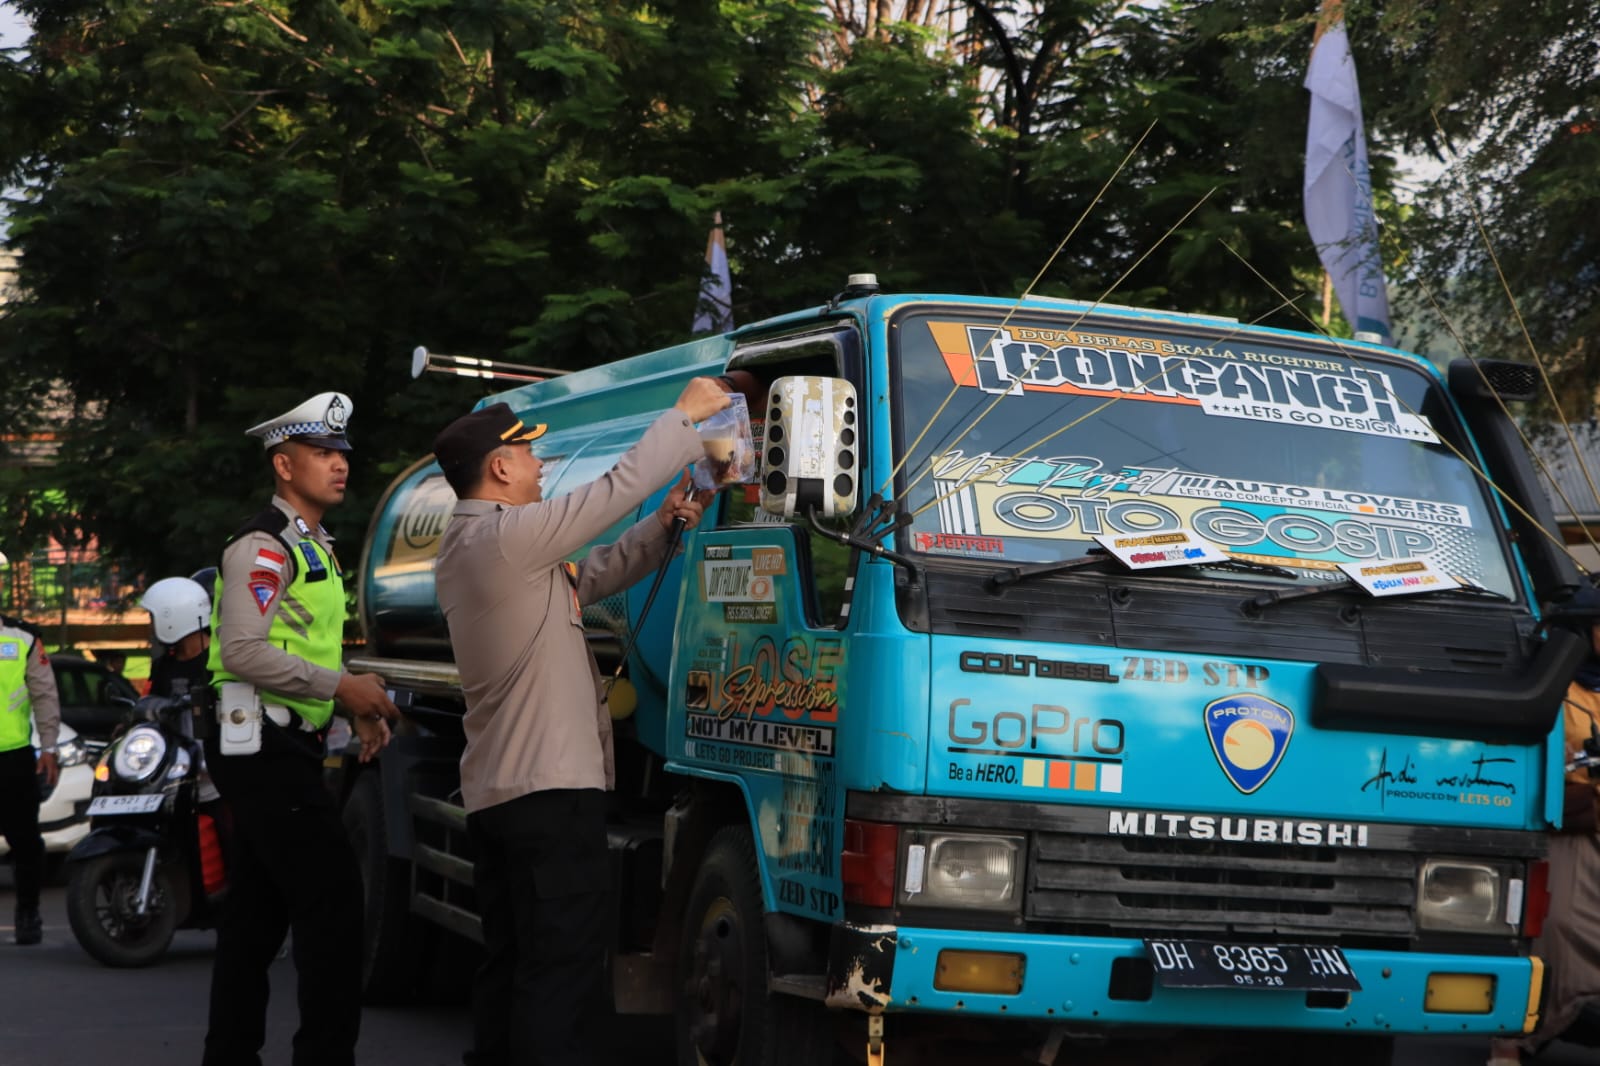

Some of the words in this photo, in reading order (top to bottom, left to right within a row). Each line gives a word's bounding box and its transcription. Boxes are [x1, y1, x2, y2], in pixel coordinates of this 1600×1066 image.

[1019, 328, 1073, 344] DUA
[1077, 332, 1155, 351] BELAS
[1162, 340, 1238, 360] SKALA
[1244, 351, 1345, 372] RICHTER
[1241, 404, 1283, 420] LETS
[1289, 410, 1323, 424] GO
[1330, 415, 1402, 435] DESIGN
[1179, 487, 1211, 497] LETS
[1214, 489, 1235, 499] GO
[1237, 492, 1297, 506] CONCEPT
[1299, 497, 1353, 511] OFFICIAL
[1211, 479, 1311, 498] AUTO
[1316, 489, 1462, 517] LOVERS
[993, 492, 1182, 537] OTO
[1191, 505, 1438, 560] GOSIP
[1377, 507, 1463, 525] DIVISION
[935, 532, 1005, 553] Ferrari
[960, 650, 1038, 678] COLT
[1035, 659, 1119, 684] DIESEL
[1122, 656, 1189, 683] ZED
[1202, 661, 1270, 688] STP
[948, 697, 1125, 755] GoPro
[1212, 706, 1288, 725] PROTON
[690, 715, 723, 737] NOT
[729, 719, 758, 742] MY
[762, 723, 830, 752] LEVEL
[694, 742, 717, 761] LETS
[734, 747, 775, 770] PROJECT
[948, 762, 964, 781] Be
[965, 769, 973, 781] a
[975, 762, 1019, 785] HERO.
[1386, 789, 1447, 801] PRODUCED
[1447, 792, 1458, 803] by
[1459, 792, 1490, 805] LETS
[1493, 795, 1512, 807] GO
[1108, 810, 1369, 847] MITSUBISHI
[779, 876, 806, 908] ZED
[809, 885, 840, 917] STP
[1151, 942, 1195, 970] DH
[1213, 945, 1288, 973] 8365
[1303, 947, 1350, 976] HN
